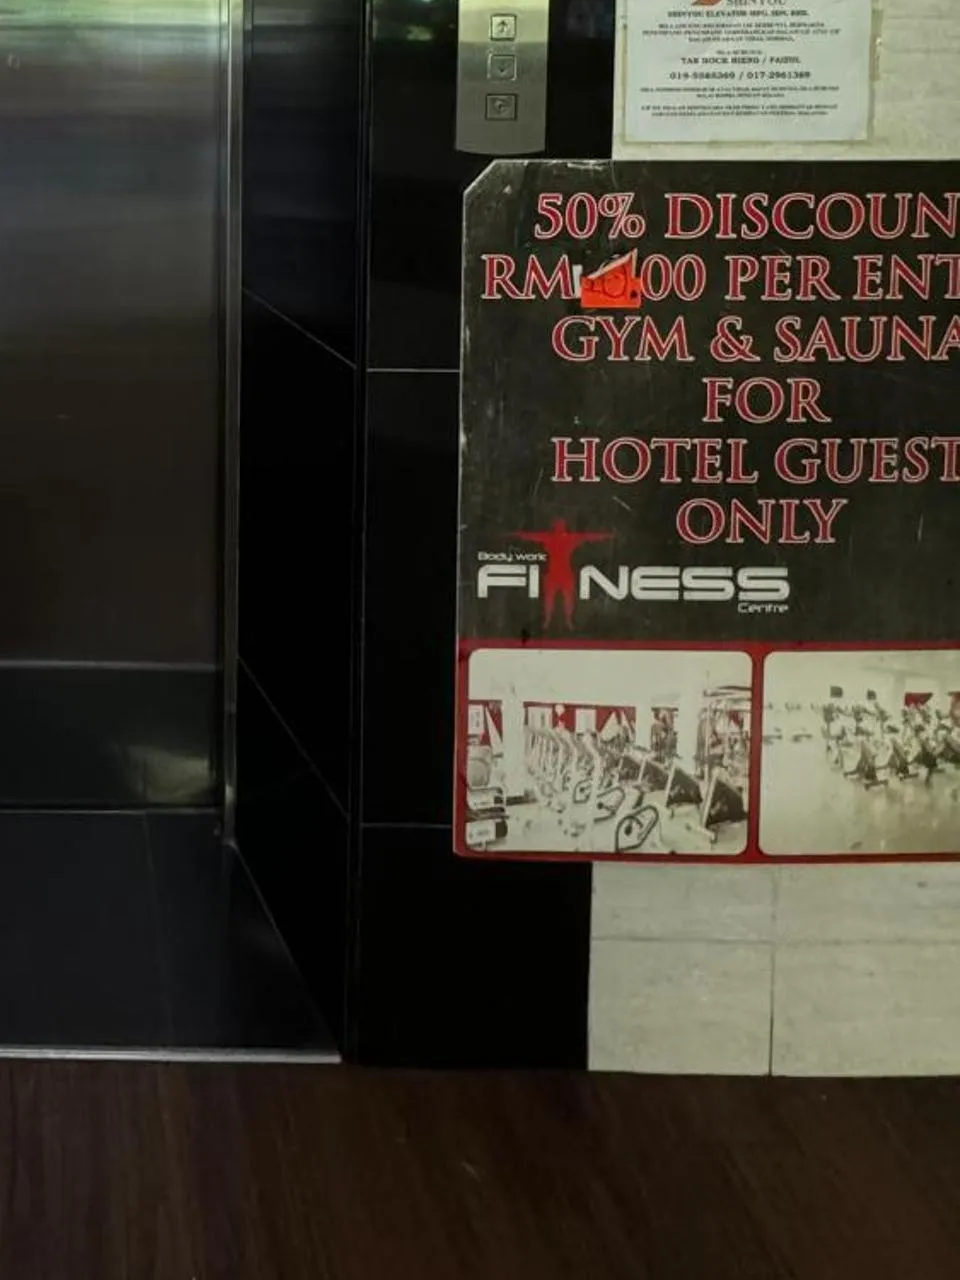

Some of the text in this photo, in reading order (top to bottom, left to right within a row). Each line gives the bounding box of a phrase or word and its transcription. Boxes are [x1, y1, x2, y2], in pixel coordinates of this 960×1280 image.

[534, 192, 960, 240] 50% DISCOUN
[725, 254, 841, 301] PER
[551, 315, 960, 363] GYM & SAUNA
[702, 376, 832, 424] FOR
[551, 436, 960, 484] HOTEL GUEST
[676, 497, 848, 545] ONLY
[478, 551, 514, 564] Body
[737, 602, 789, 614] Centre
